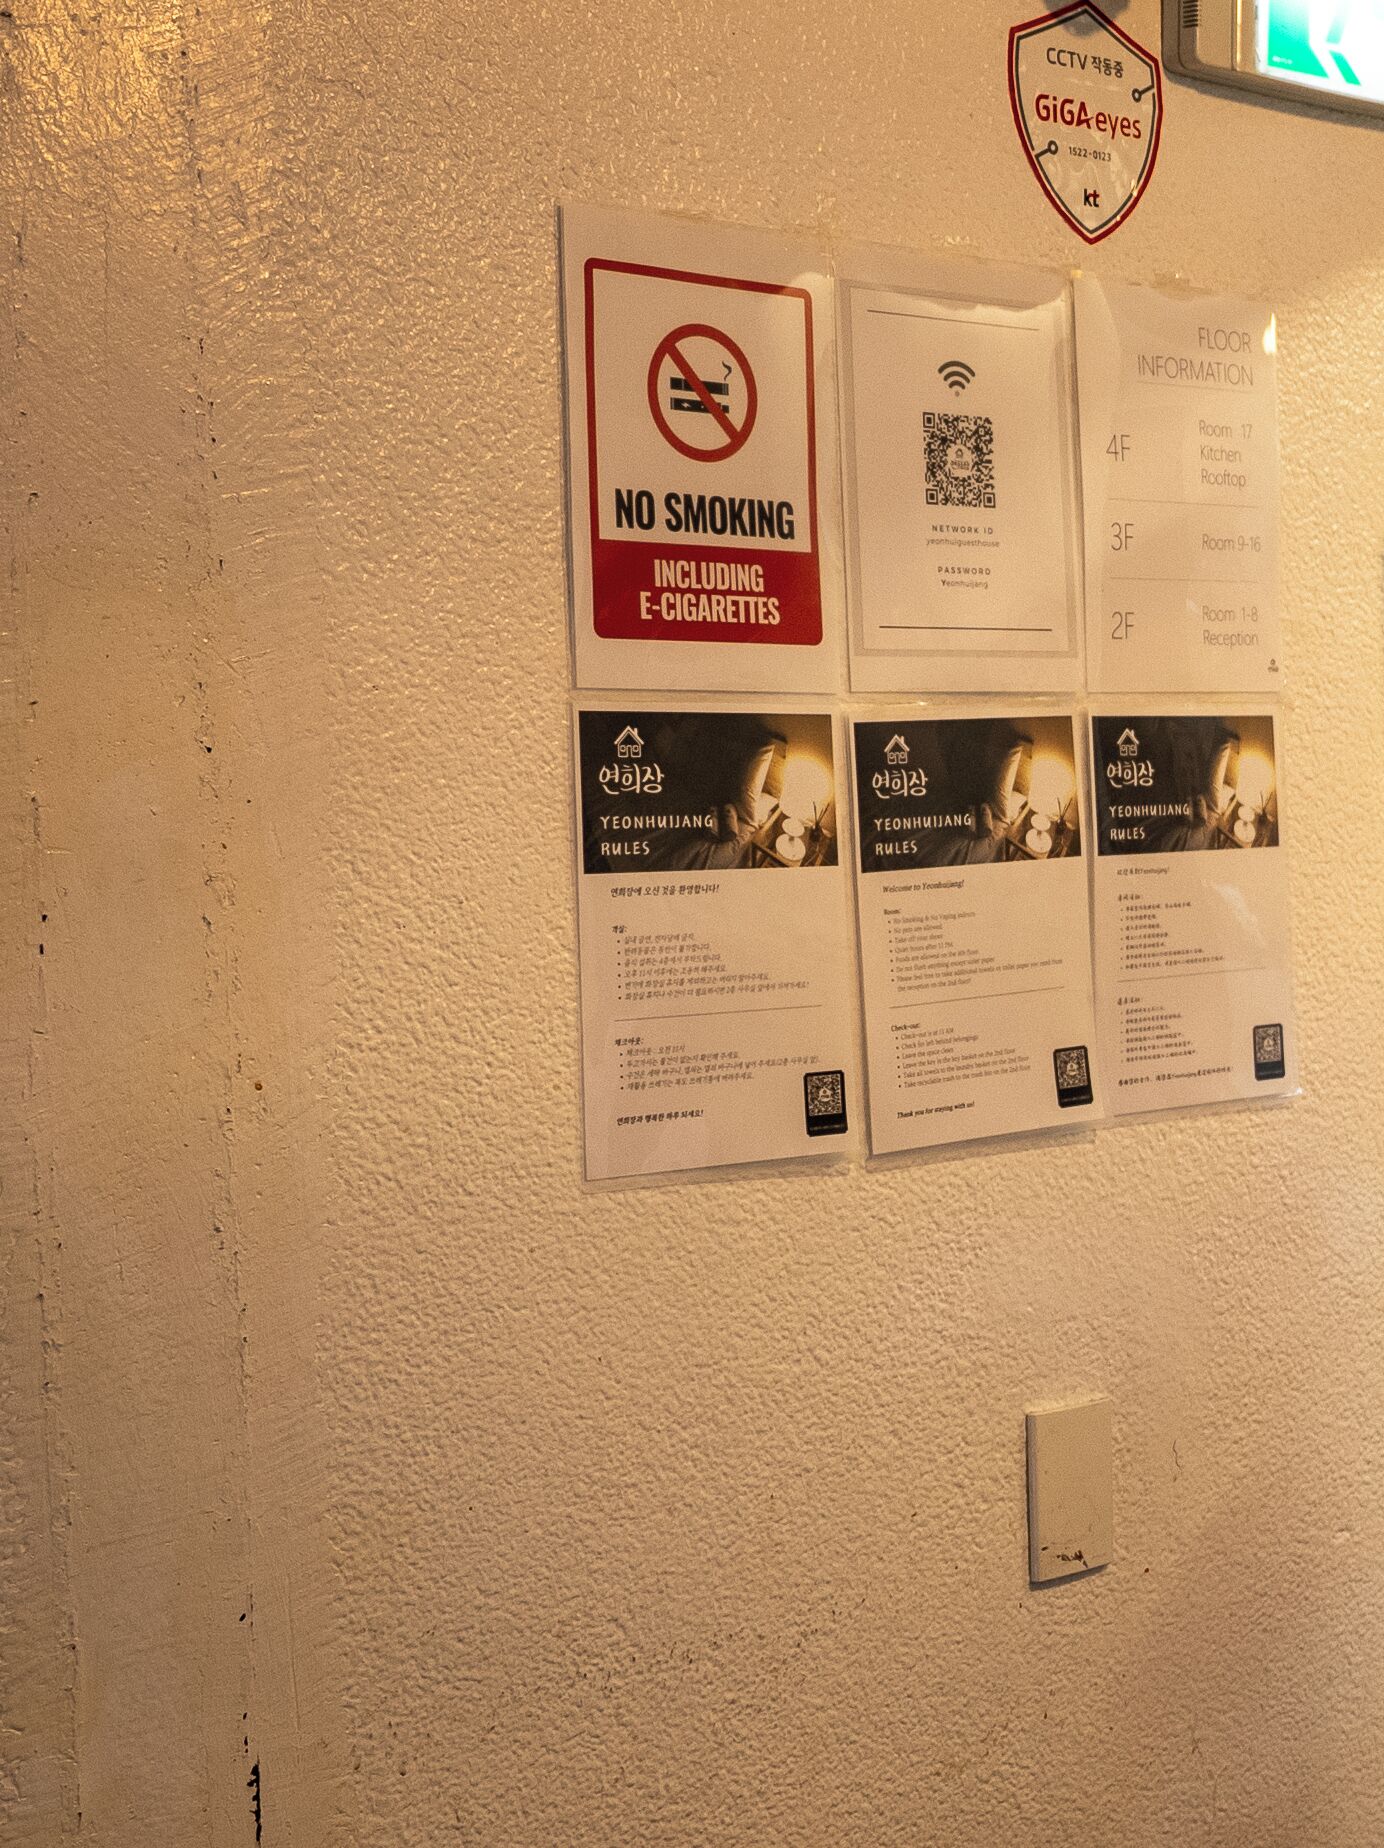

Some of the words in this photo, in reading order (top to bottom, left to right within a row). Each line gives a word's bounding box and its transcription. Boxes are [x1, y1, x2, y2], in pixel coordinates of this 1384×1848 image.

[1046, 47, 1087, 71] CCTV
[1091, 56, 1125, 79] 작동중
[1068, 145, 1112, 162] 1522-0123
[1083, 188, 1100, 208] kt
[1198, 327, 1252, 353] FLOOR
[1137, 354, 1254, 386] INFORMATION
[1199, 420, 1233, 438] Room
[1241, 424, 1253, 438] 17
[1106, 435, 1131, 462] 4F
[1199, 444, 1241, 464] Kitchen
[1201, 468, 1247, 491] Rooftop
[616, 488, 656, 530] NO
[665, 493, 795, 540] SMOKING
[931, 524, 979, 534] NETWORK
[984, 527, 993, 535] ID
[1111, 522, 1134, 551] 3F
[1202, 534, 1235, 551] Room
[1237, 536, 1261, 553] 9-16
[654, 559, 764, 593] INCLUDING
[937, 566, 991, 576] PASSWORD
[640, 591, 780, 625] E-CIGARETTES
[1202, 605, 1235, 622] Room
[1240, 607, 1259, 622] 1-8
[1111, 612, 1135, 640] 2F
[1203, 629, 1259, 648] Reception
[599, 763, 664, 795] 연희장
[872, 768, 928, 799] 연희장
[1107, 760, 1155, 788] 연희장
[1108, 803, 1190, 818] YEONHUIJANG
[600, 814, 713, 830] YEONHUIJANG
[873, 813, 972, 831] YEONHUIJANG
[1110, 827, 1145, 840] RULES
[601, 841, 650, 856] RULES
[875, 840, 918, 856] RULES
